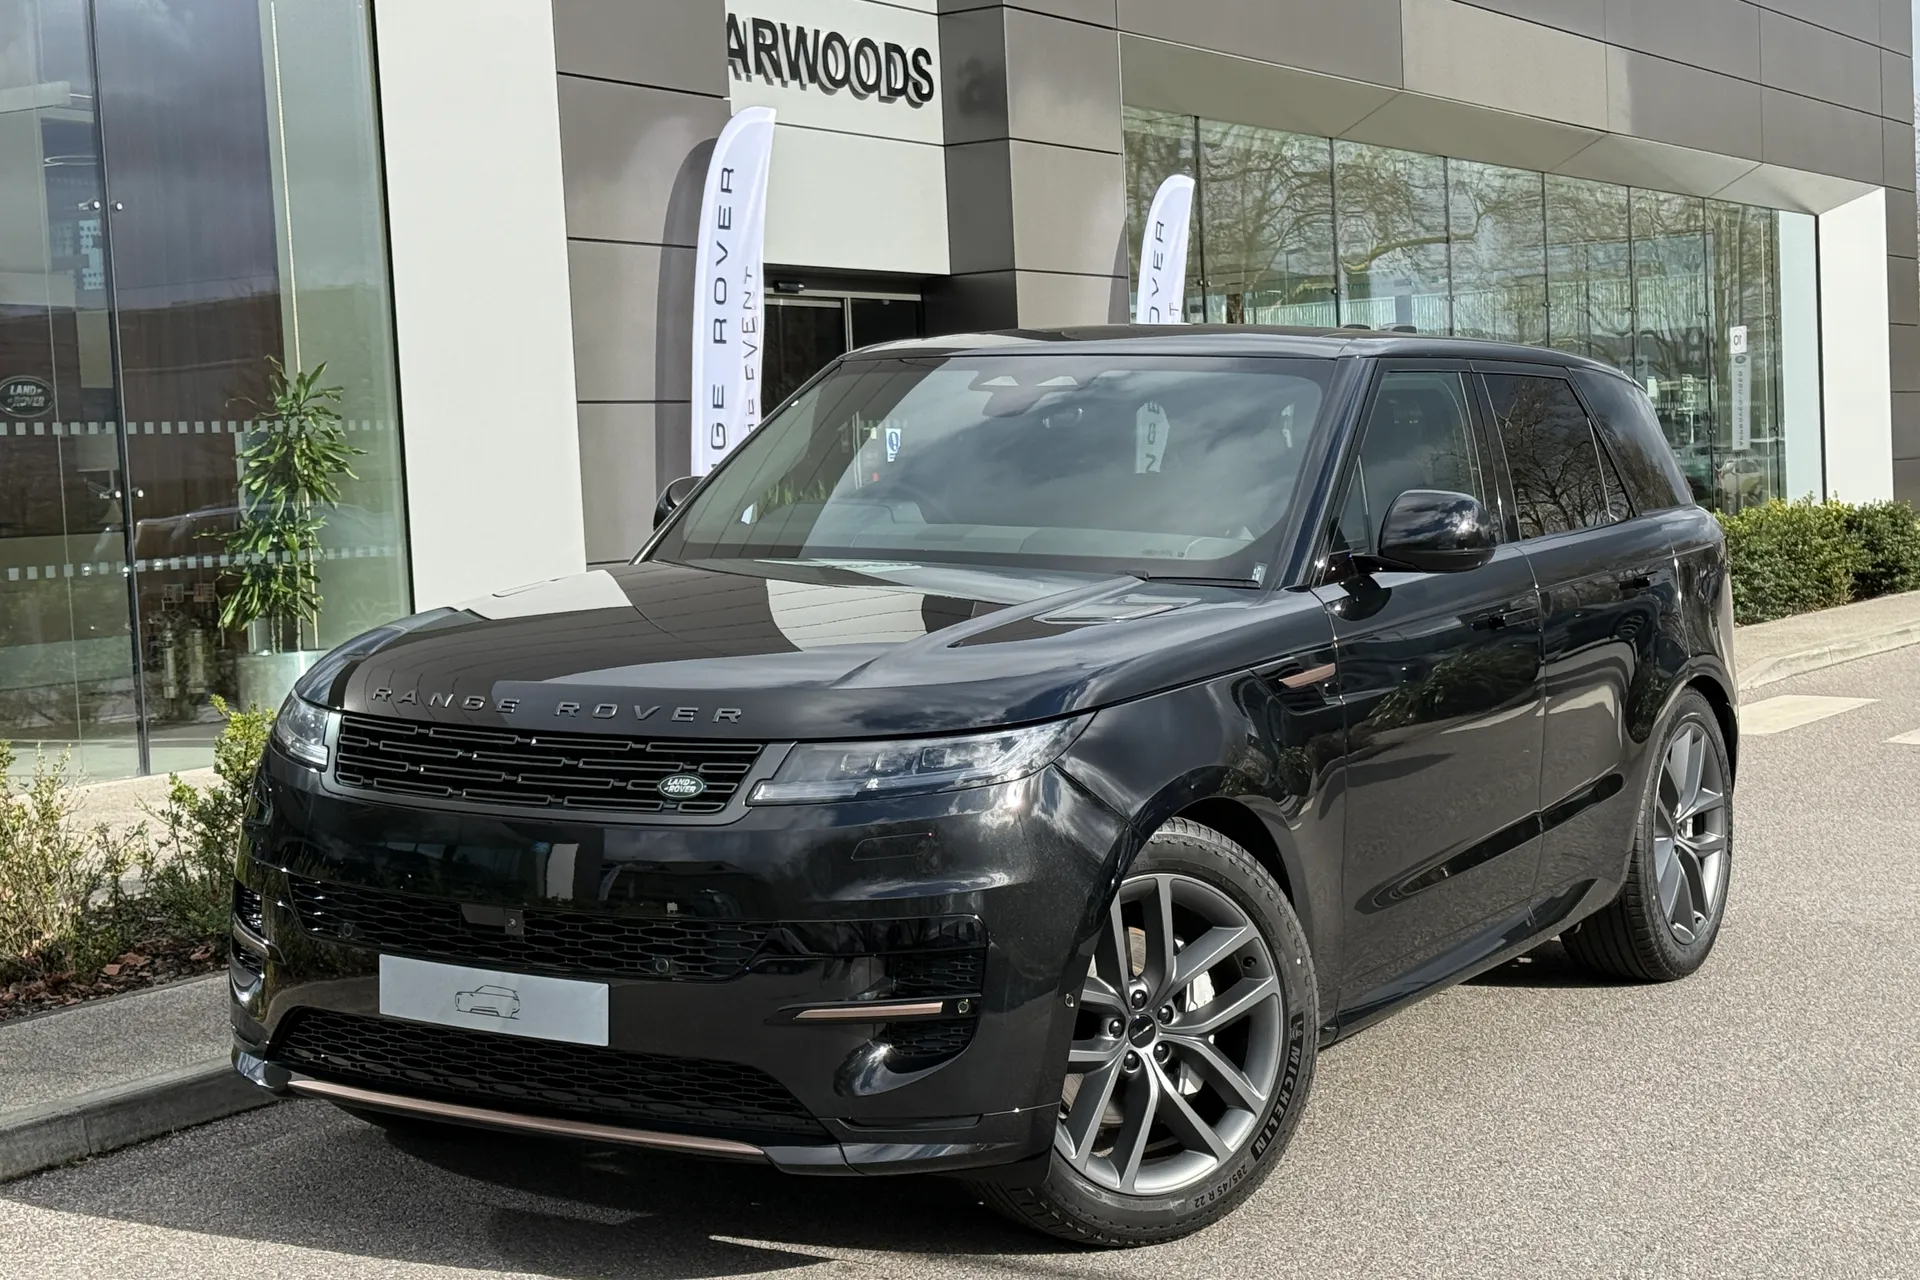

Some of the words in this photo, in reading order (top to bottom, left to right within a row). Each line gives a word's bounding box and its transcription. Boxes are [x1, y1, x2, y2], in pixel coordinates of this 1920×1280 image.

[727, 13, 934, 103] ARWOODS
[713, 167, 734, 344] ROVER
[742, 266, 758, 380] EVENT
[10, 385, 37, 396] LAND
[711, 385, 726, 468] GE
[372, 687, 520, 714] RANGE
[553, 701, 742, 724] ROVER
[667, 785, 697, 793] ROVER
[1254, 1045, 1300, 1154] MICHELIN
[1217, 1164, 1247, 1197] 285/45
